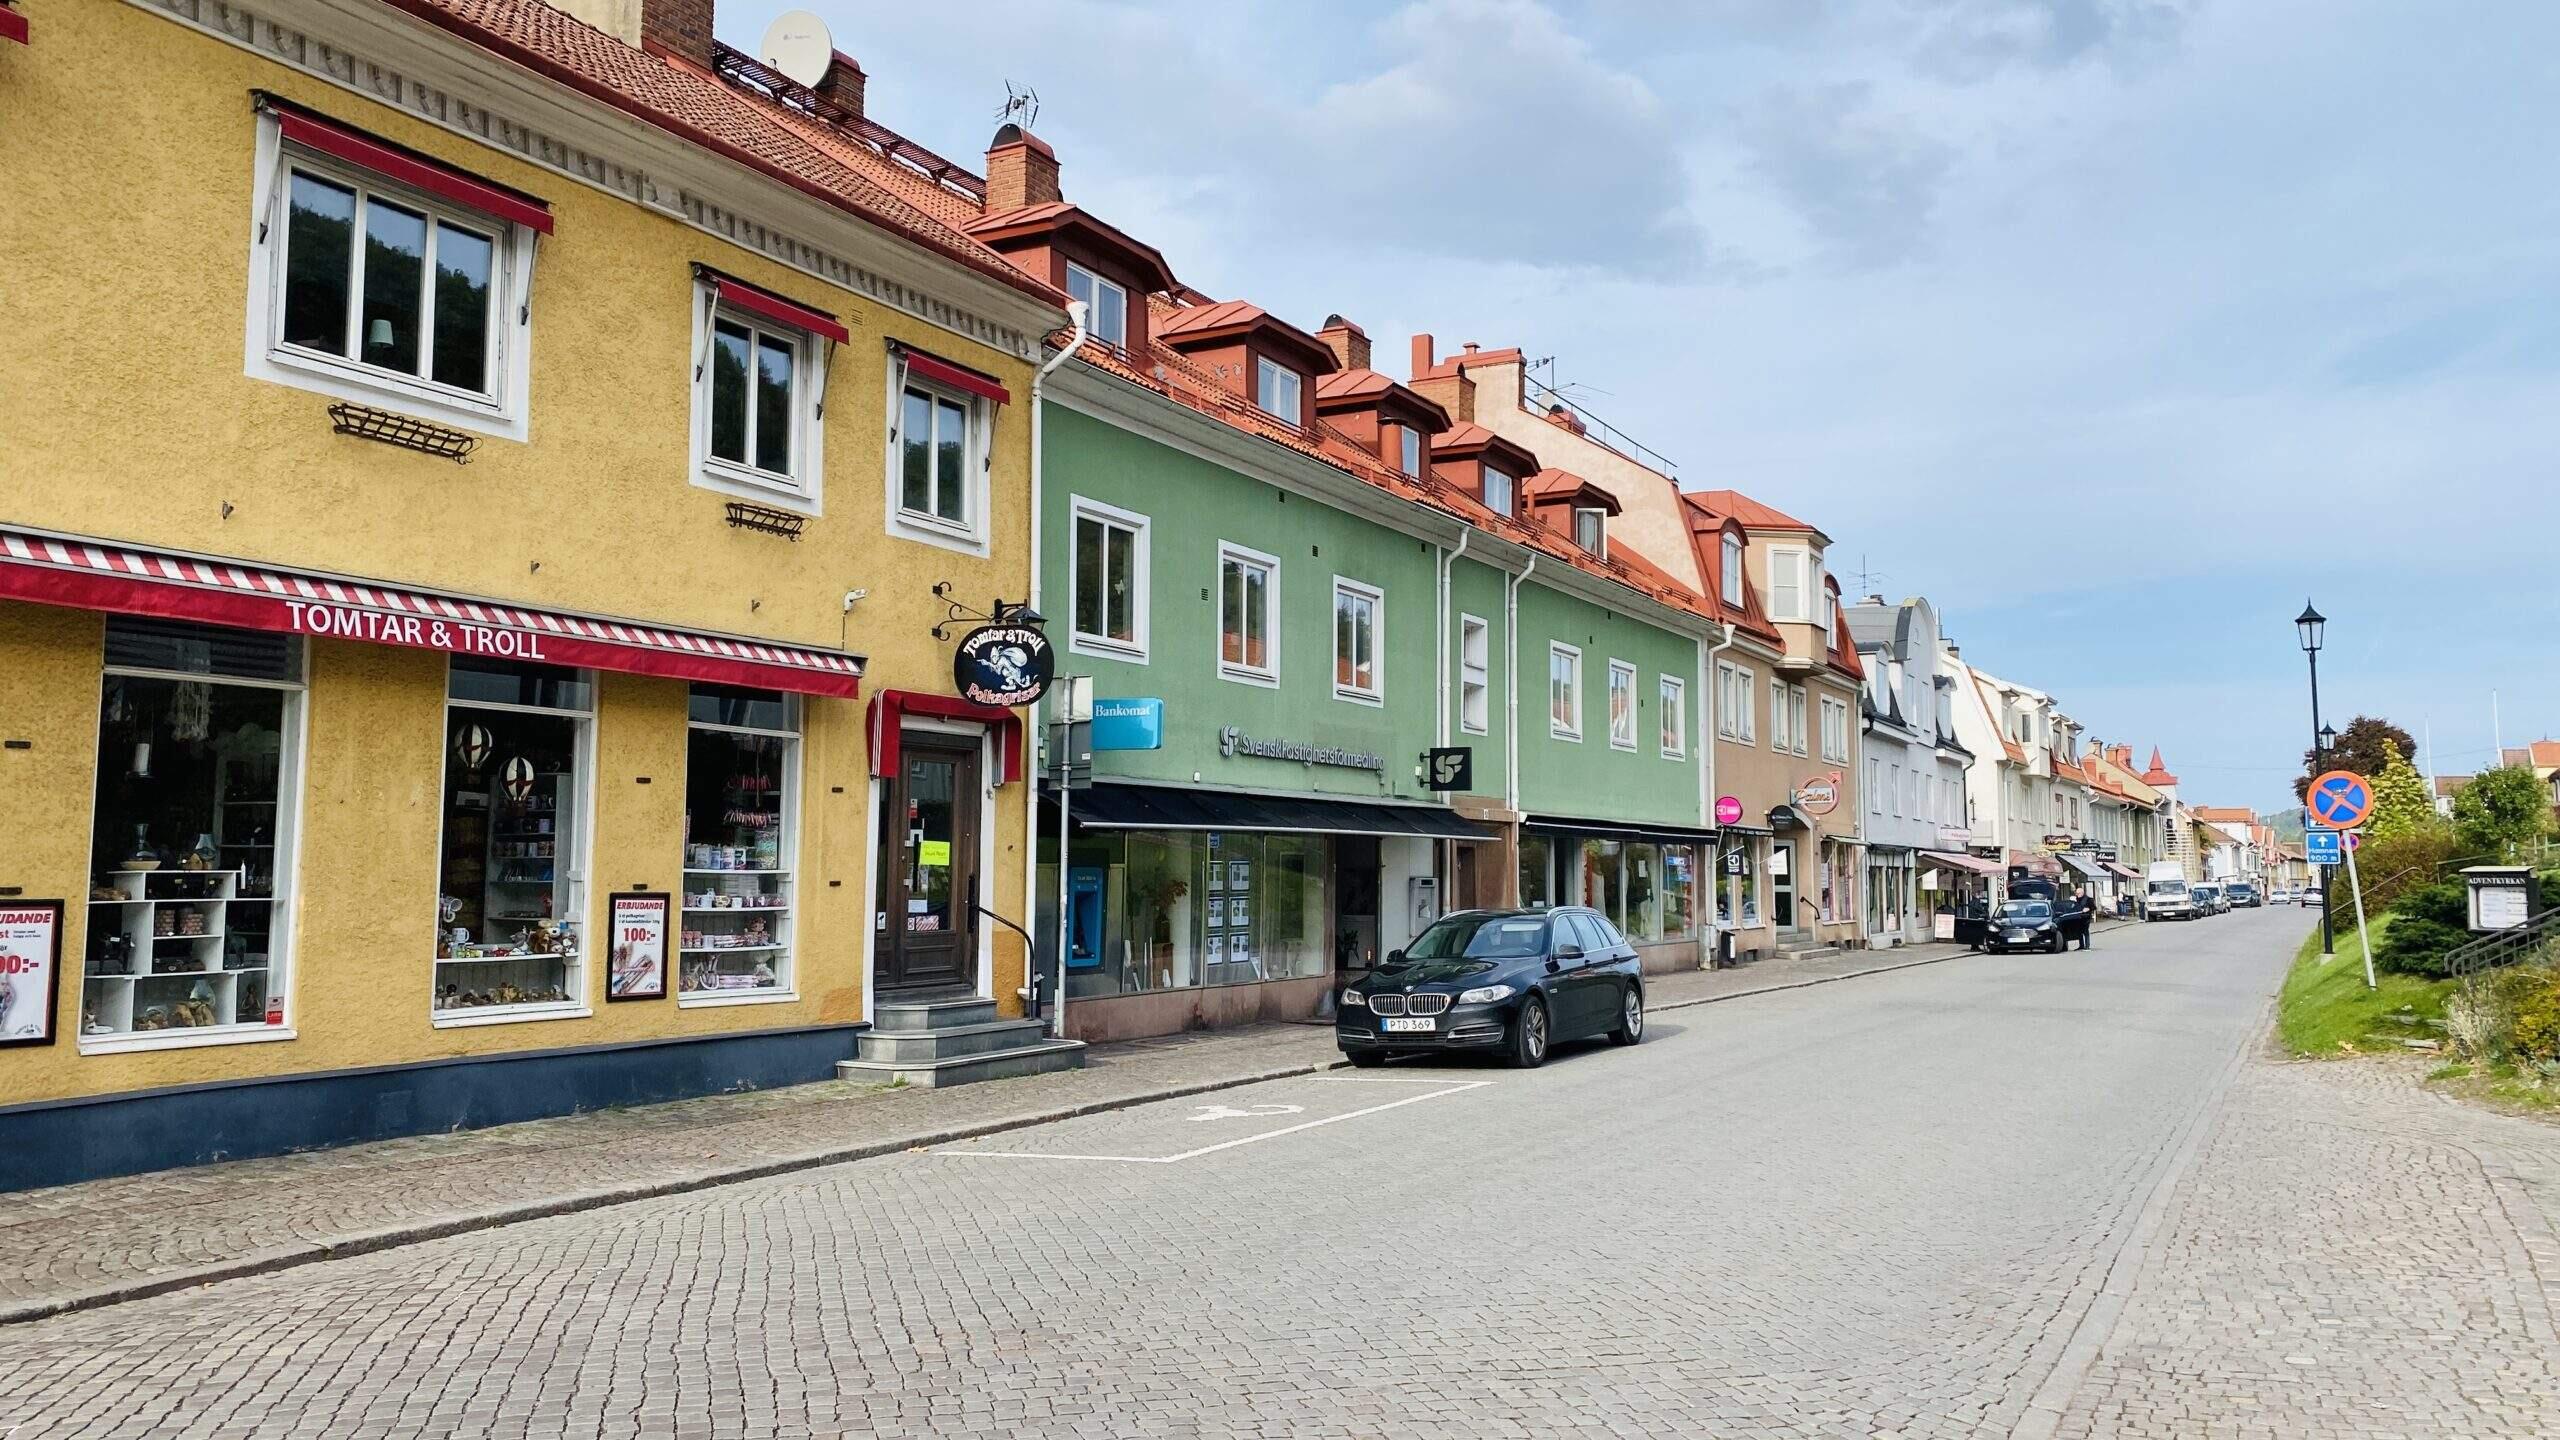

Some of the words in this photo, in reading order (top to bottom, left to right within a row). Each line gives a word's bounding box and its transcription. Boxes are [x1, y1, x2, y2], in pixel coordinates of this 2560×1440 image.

[286, 601, 423, 645] TOMTAR
[430, 621, 453, 648] &
[459, 624, 545, 660] TROLL
[1005, 629, 1016, 643] &
[1015, 629, 1046, 656] Troll
[1095, 704, 1151, 717] Bankomat
[617, 902, 664, 910] ERBJUDANDE
[624, 928, 656, 941] 100:-
[1390, 1020, 1409, 1030] PTD
[1412, 1020, 1431, 1030] 369
